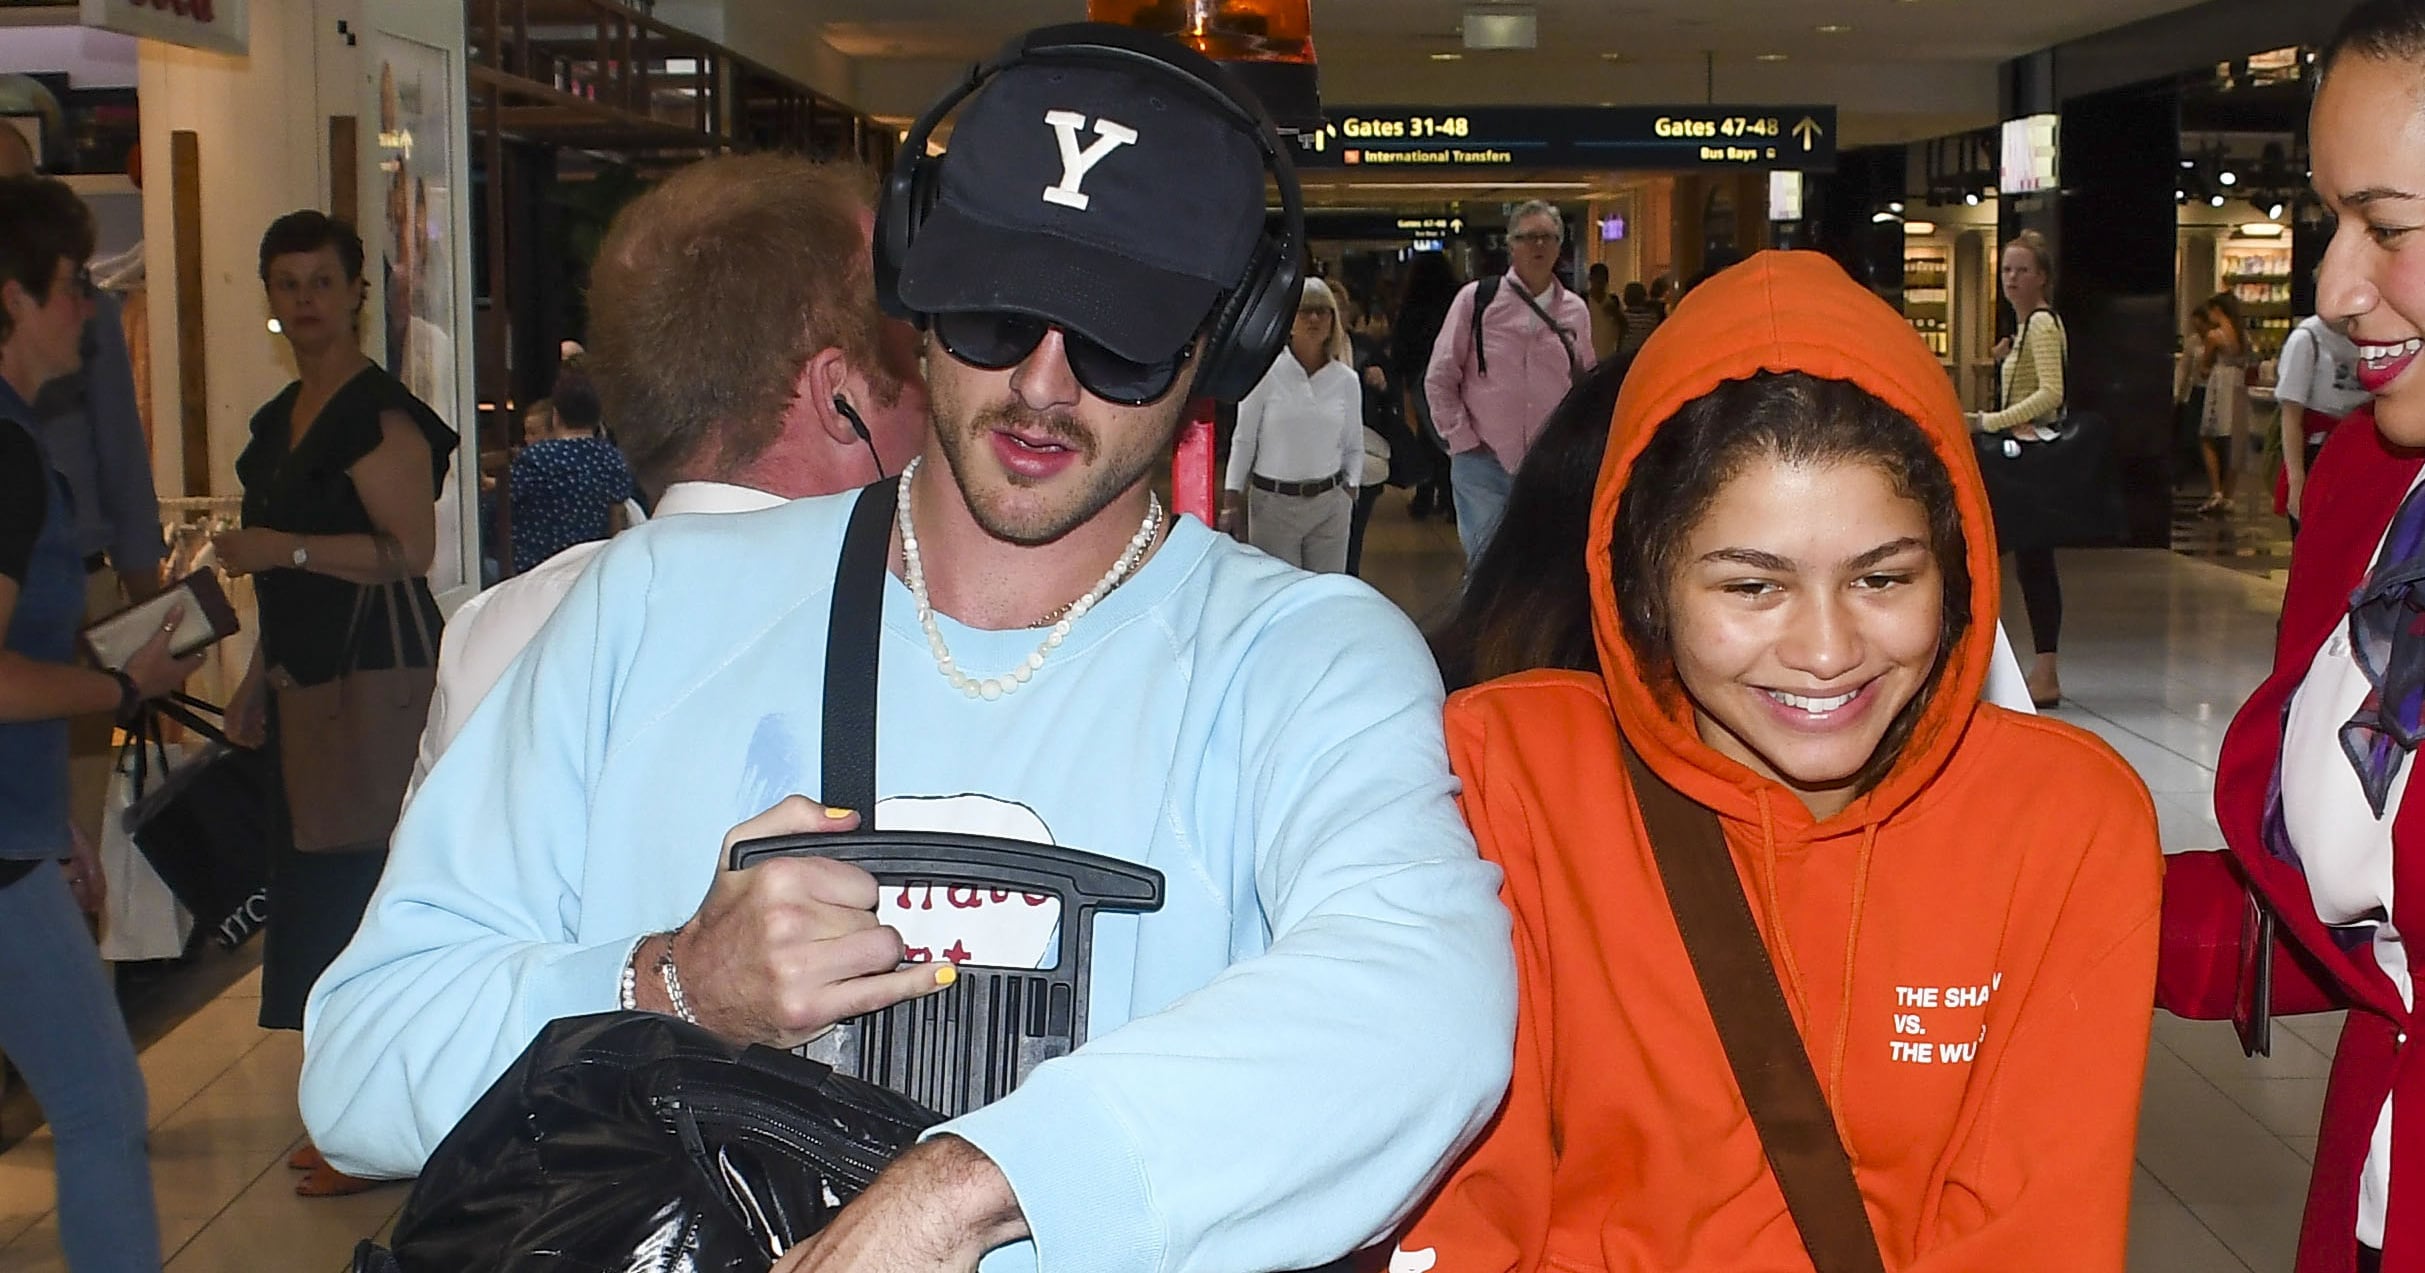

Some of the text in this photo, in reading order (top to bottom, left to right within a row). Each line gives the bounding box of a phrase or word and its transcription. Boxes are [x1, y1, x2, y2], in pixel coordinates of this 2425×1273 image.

[1343, 117, 1469, 137] Gates 31-48
[1655, 117, 1779, 137] Gates 47-48
[1043, 109, 1138, 211] Y
[1364, 150, 1511, 163] International Transfers
[1700, 147, 1757, 162] Bus Bays
[1895, 986, 1939, 1007] THE
[1893, 1013, 1926, 1035] VS.
[1889, 1040, 1933, 1063] THE
